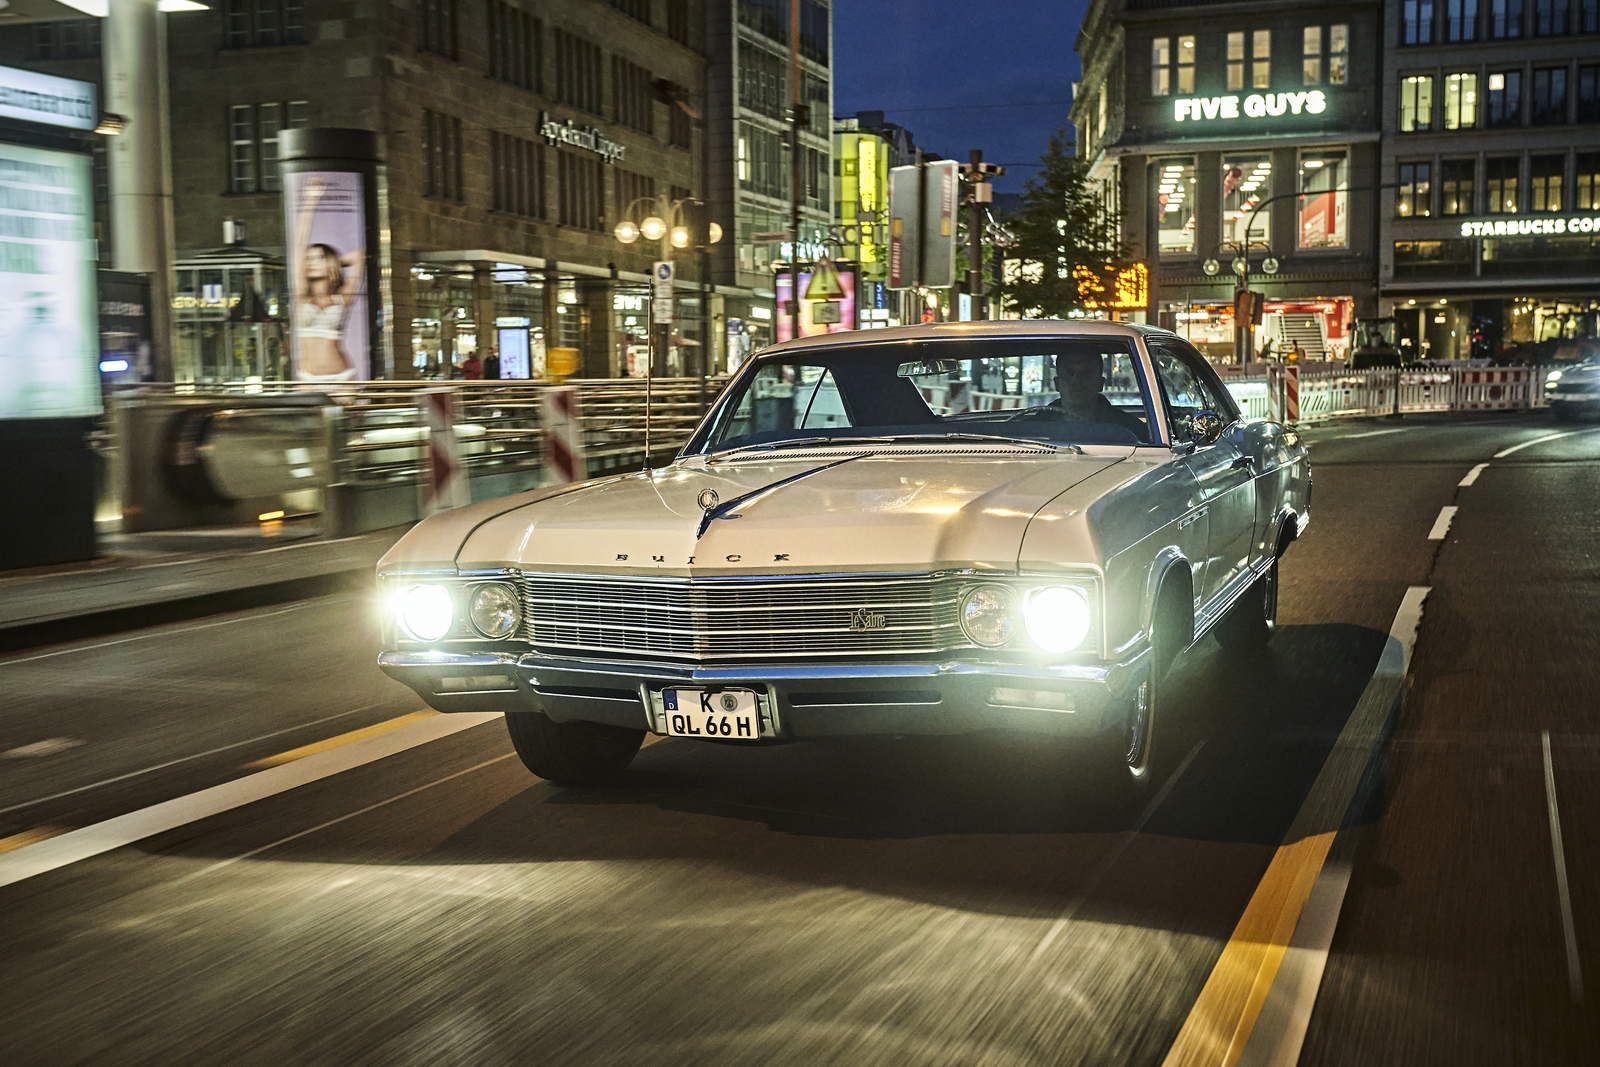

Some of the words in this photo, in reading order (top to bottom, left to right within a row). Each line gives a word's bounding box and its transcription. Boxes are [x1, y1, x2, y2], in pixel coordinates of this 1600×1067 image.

[1175, 96, 1239, 122] FIVE
[1244, 90, 1327, 118] GUYS
[1461, 219, 1566, 237] STARBUCKS
[616, 553, 790, 565] BUICK
[668, 702, 675, 710] D
[700, 692, 715, 713] K
[672, 715, 700, 735] QL
